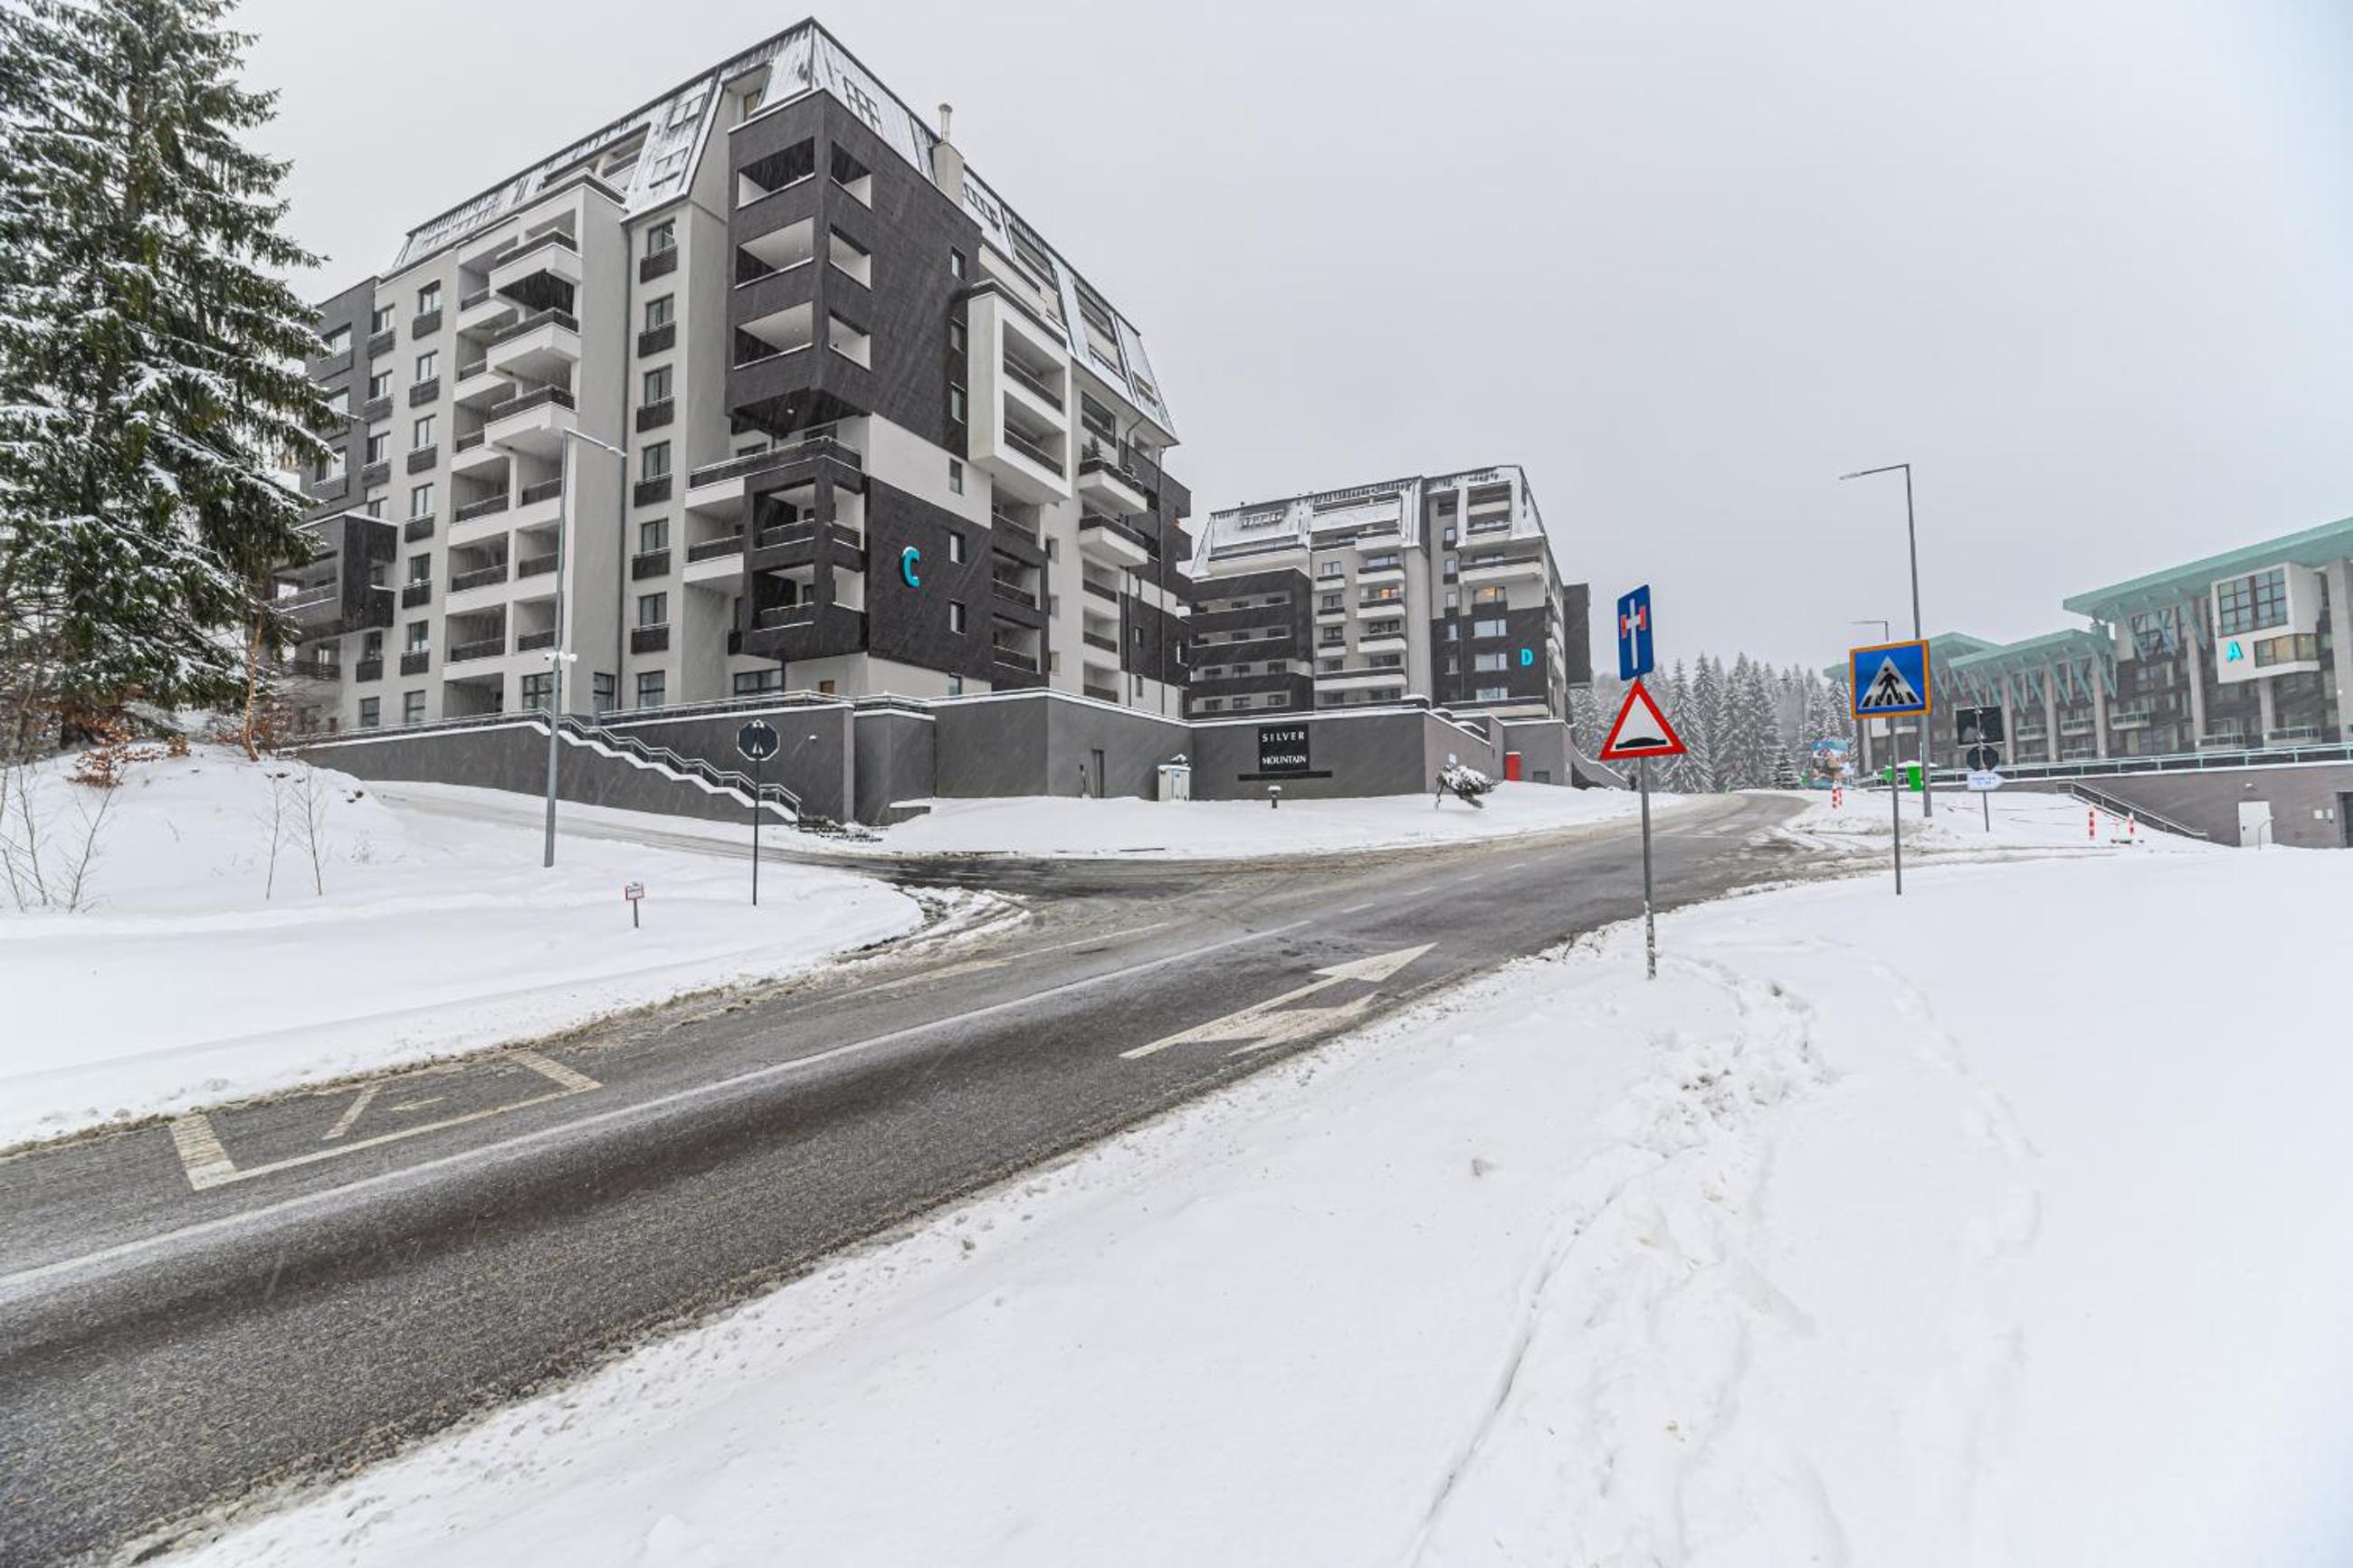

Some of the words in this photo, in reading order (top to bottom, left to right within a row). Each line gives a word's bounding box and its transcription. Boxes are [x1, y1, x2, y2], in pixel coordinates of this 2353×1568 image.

[902, 546, 920, 588] C
[1520, 648, 1533, 666] D
[2227, 641, 2243, 662] A
[1262, 731, 1305, 742] SILVER
[1262, 755, 1307, 765] MOUNTAIN
